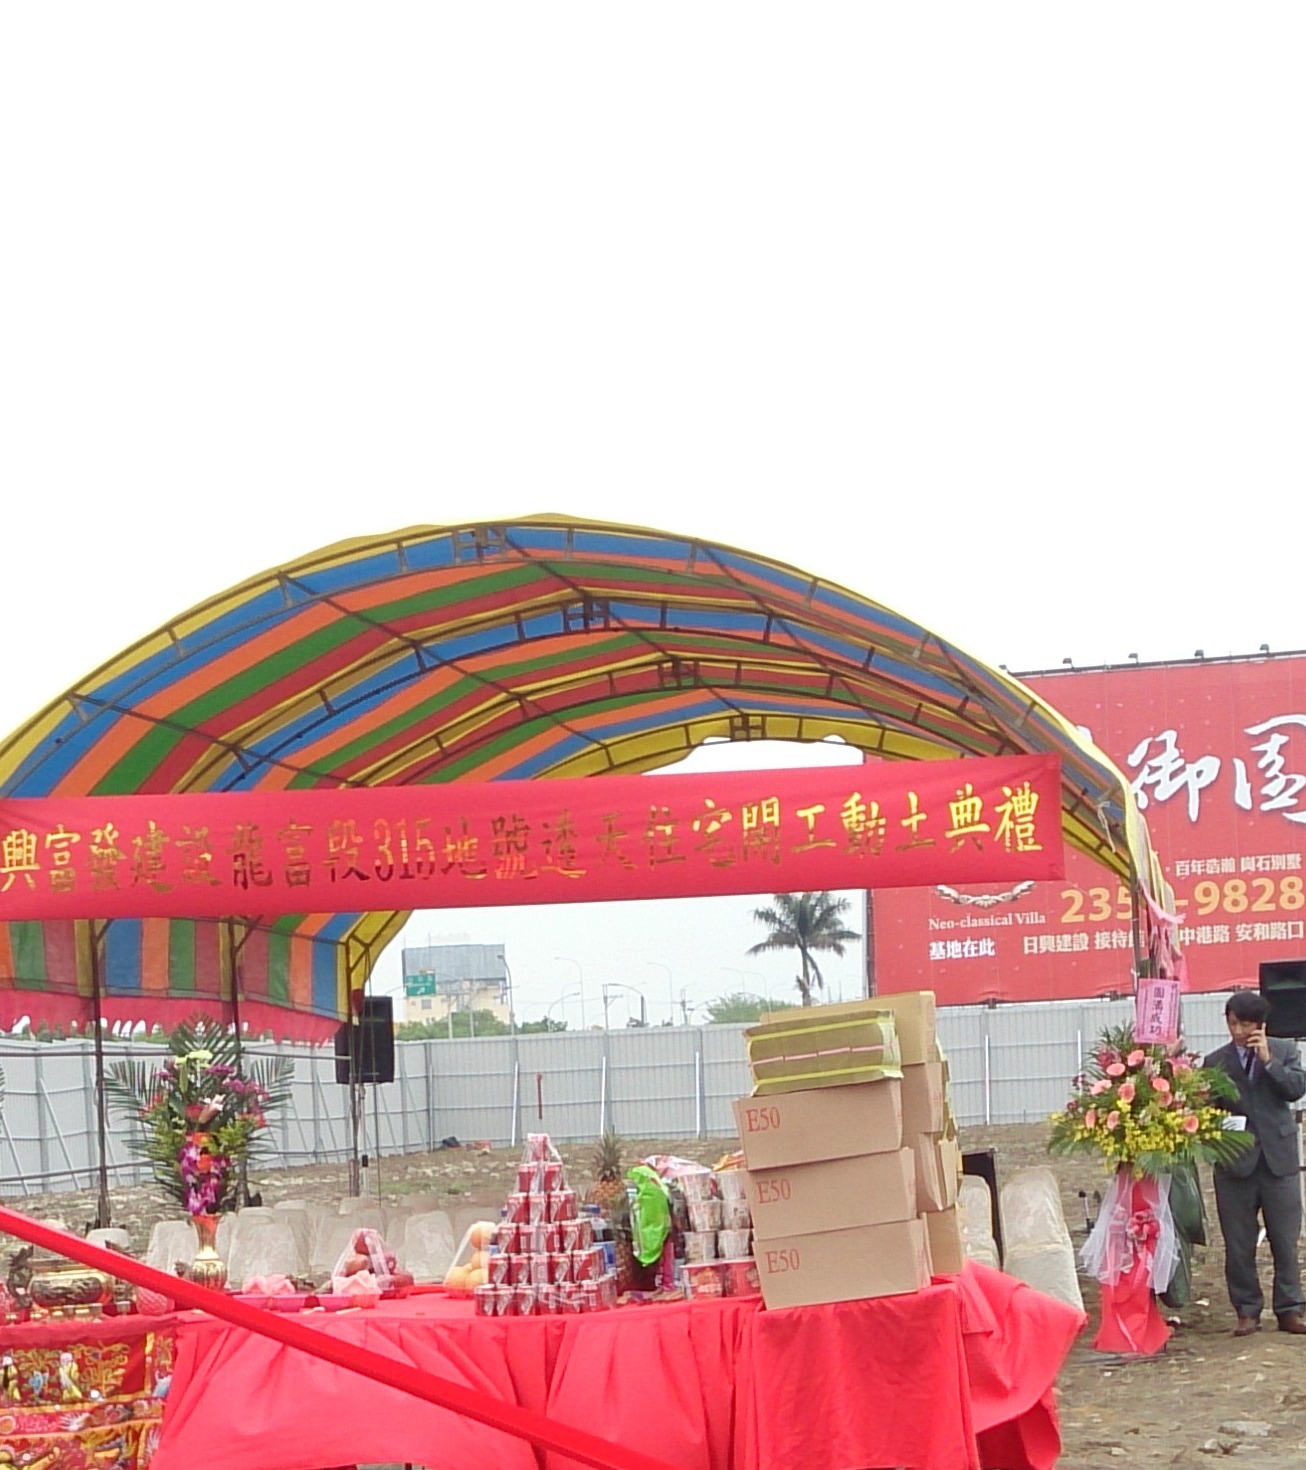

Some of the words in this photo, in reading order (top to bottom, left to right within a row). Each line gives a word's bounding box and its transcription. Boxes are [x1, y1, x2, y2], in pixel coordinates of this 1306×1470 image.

[1060, 875, 1305, 923] 235-9828
[928, 913, 1014, 931] Neo-classical
[1016, 911, 1046, 926] Villa
[929, 939, 996, 961] 基地在此
[1023, 933, 1089, 955] 日興建設
[1236, 921, 1304, 942] 安和路口
[746, 1107, 781, 1132] E50
[756, 1179, 791, 1204] E50
[765, 1249, 800, 1274] E50
